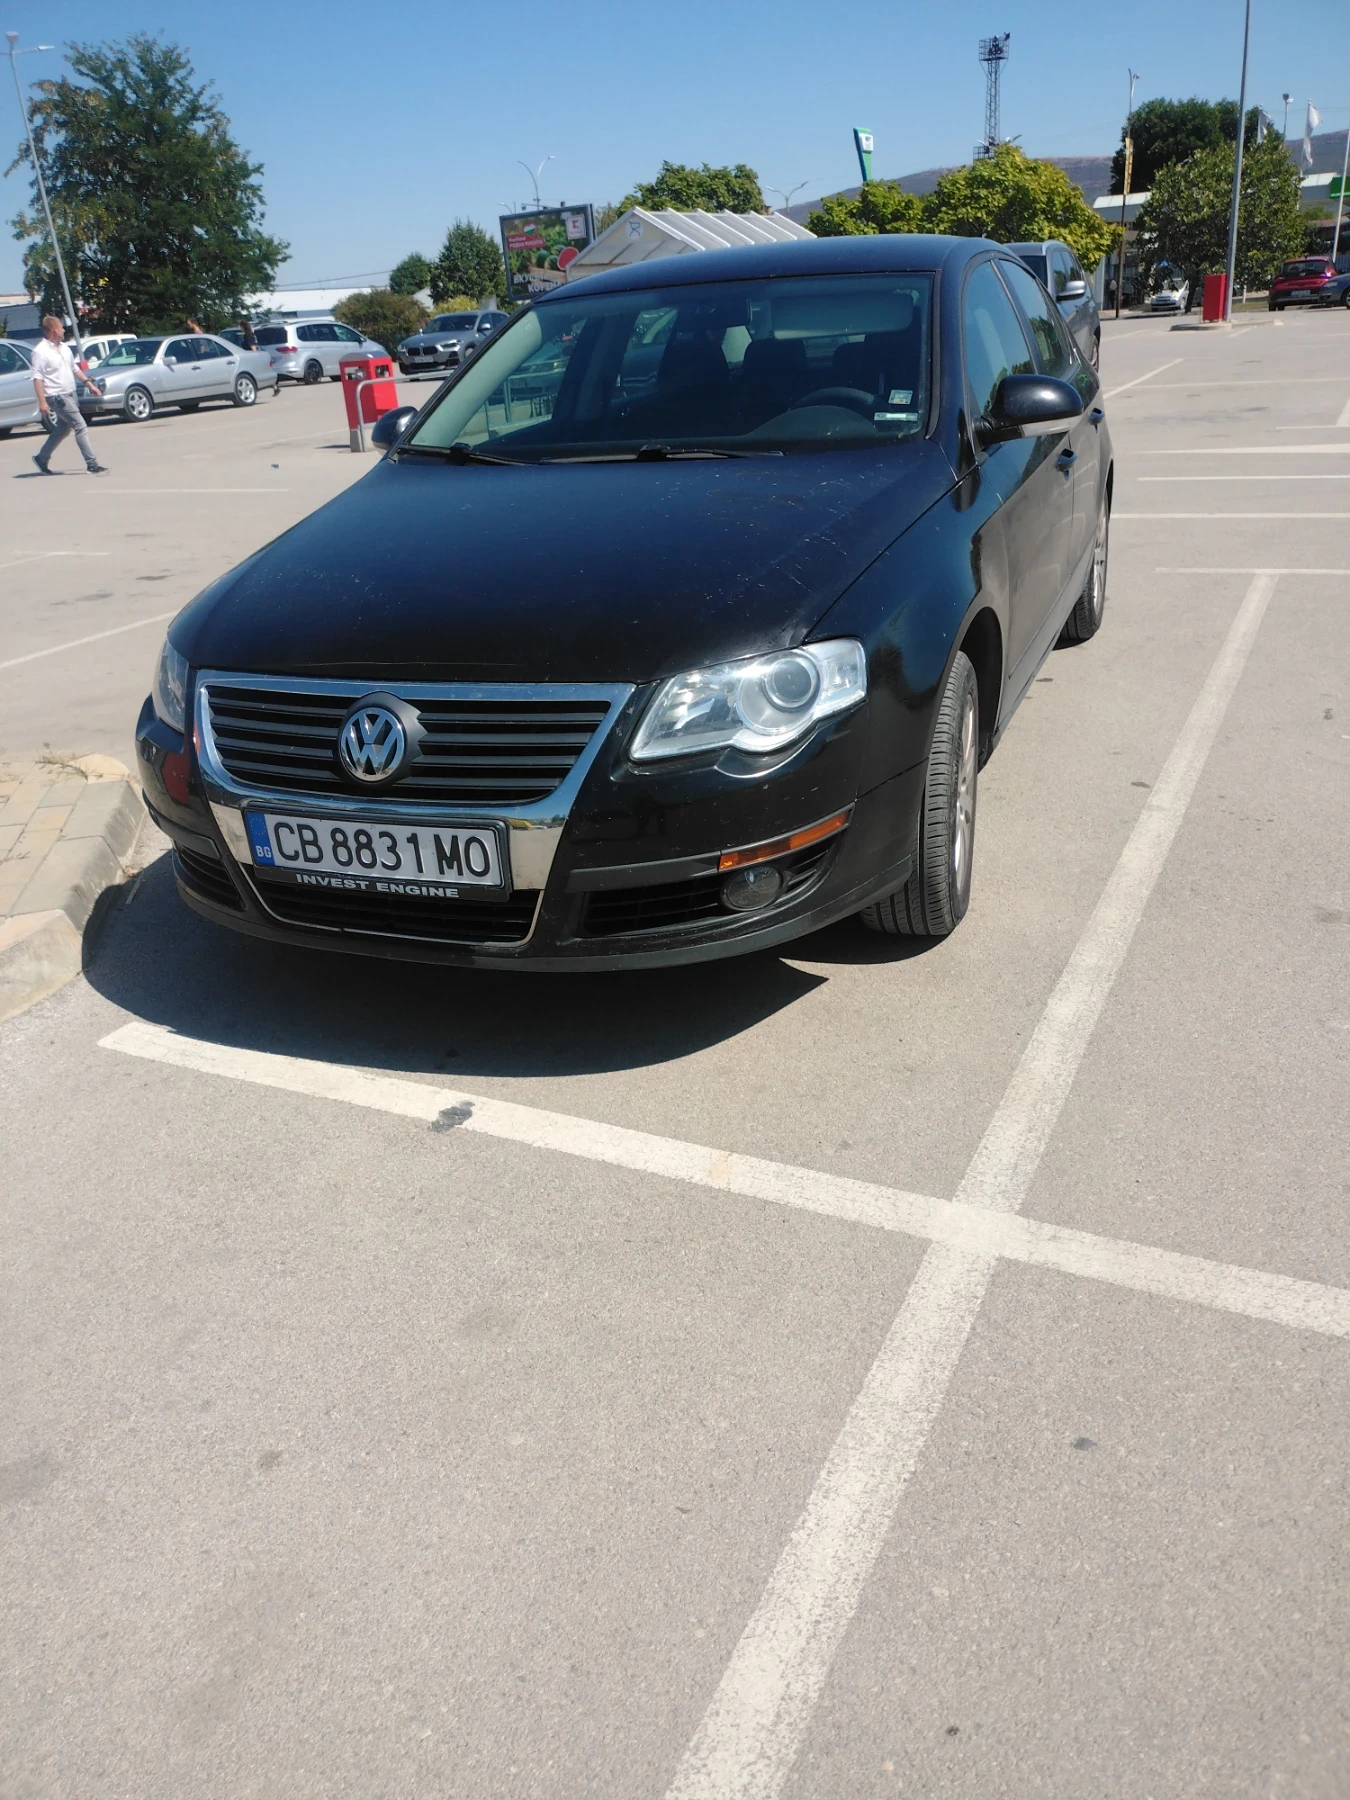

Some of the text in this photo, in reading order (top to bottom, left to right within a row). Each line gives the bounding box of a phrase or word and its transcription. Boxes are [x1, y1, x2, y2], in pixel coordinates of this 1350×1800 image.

[255, 845, 272, 858] BG
[273, 822, 491, 877] CB 8831 MO
[295, 873, 460, 898] INVEST ENGINE
